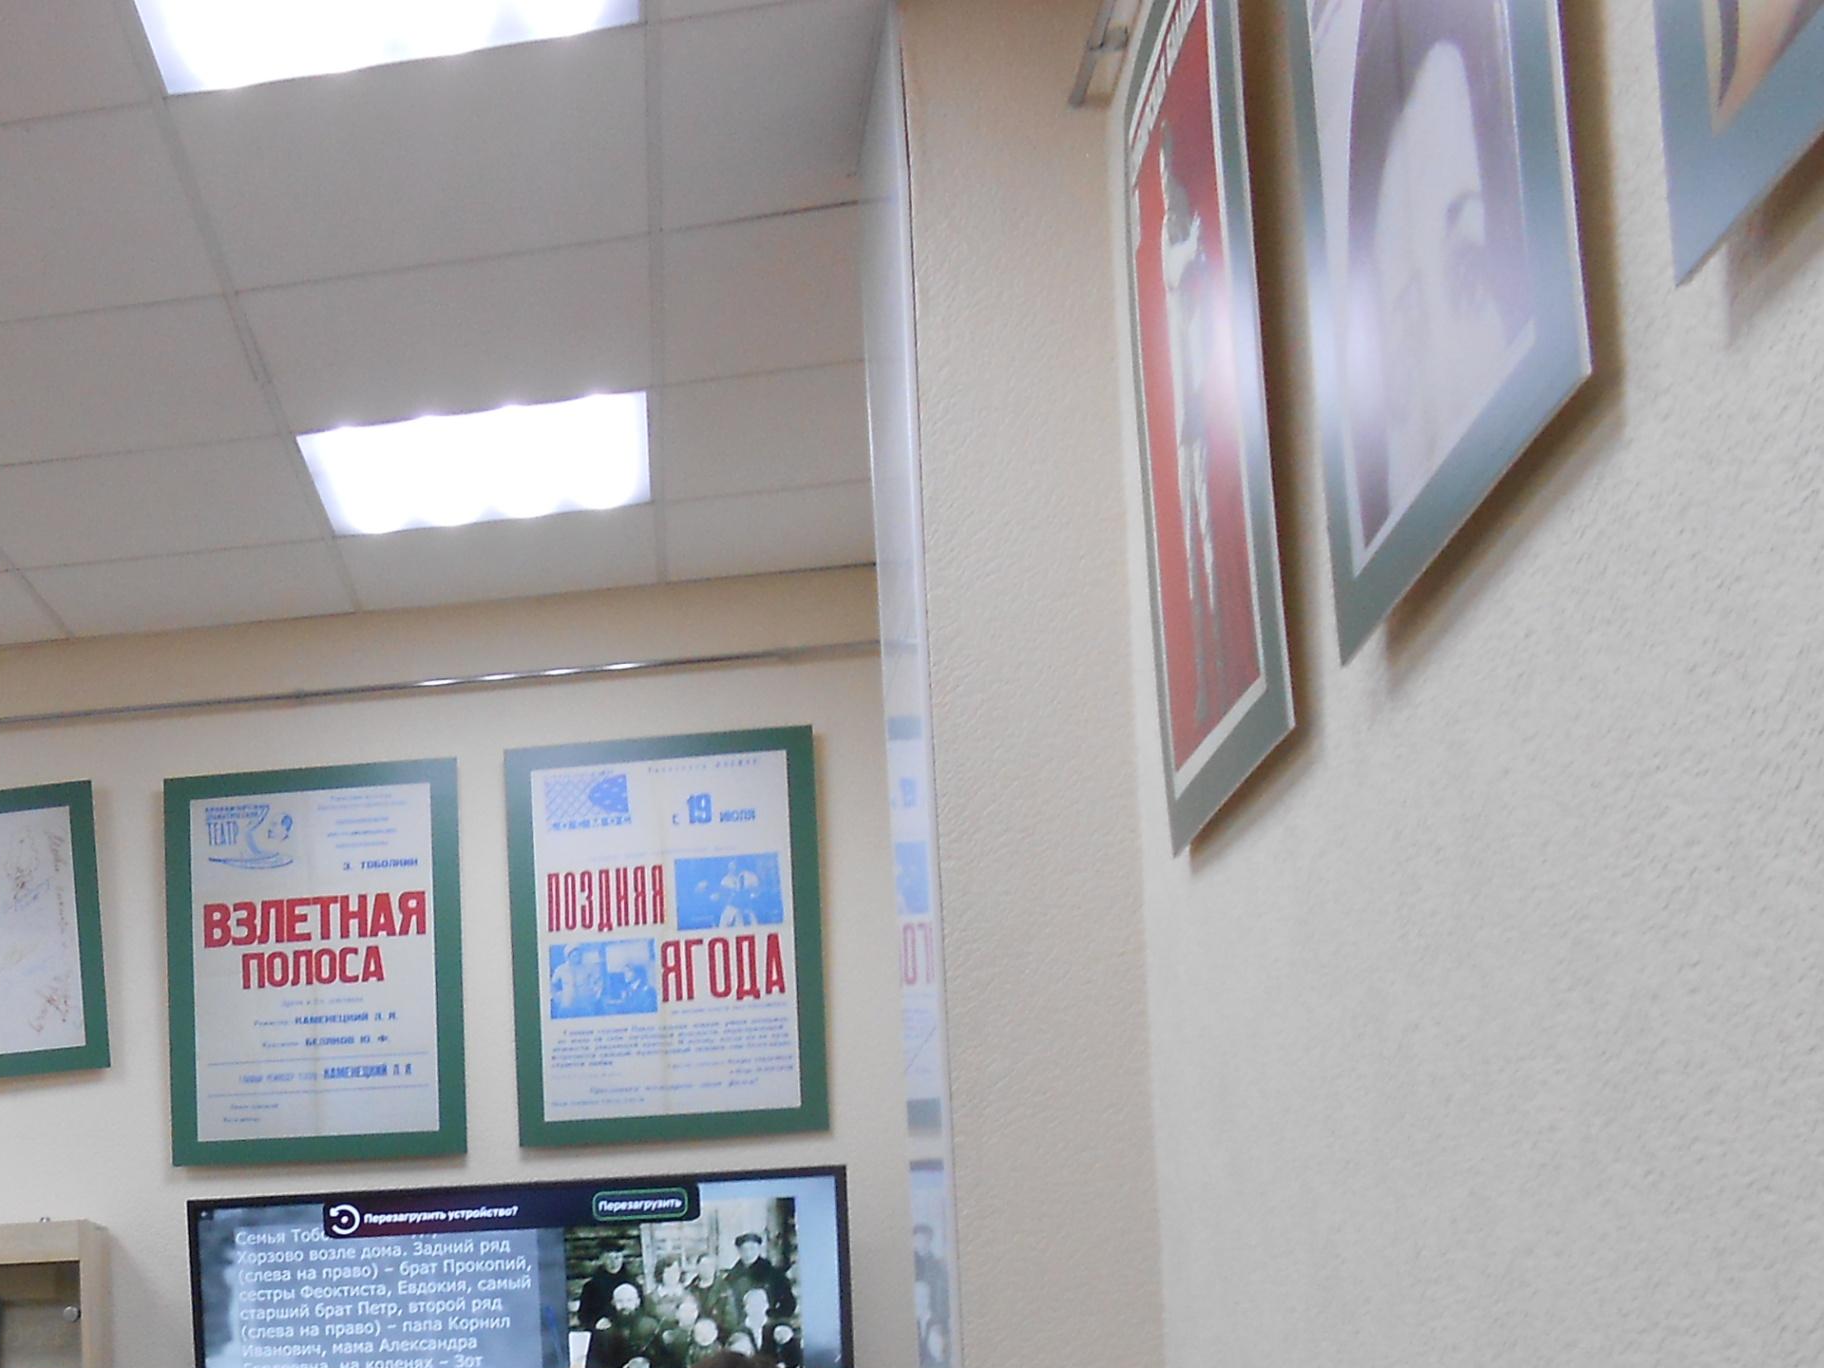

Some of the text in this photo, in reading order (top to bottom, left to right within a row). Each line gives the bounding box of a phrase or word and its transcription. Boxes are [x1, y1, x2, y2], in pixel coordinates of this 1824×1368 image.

[688, 793, 713, 824] 19
[207, 820, 240, 846] ТЕАТР
[547, 864, 666, 933] ПОЗДНЯЯ
[203, 890, 426, 949] ВЗЛЕТНАЯ
[241, 945, 386, 990] ПОЛОСА
[660, 932, 786, 1002] ЯГОДА
[364, 1206, 518, 1225] Перезагрузить устройство?
[598, 1199, 683, 1213] Перезагрузить
[235, 1231, 285, 1246] Семья
[237, 1239, 511, 1266] Хорзово возле дома. Задний ряд
[238, 1269, 291, 1284] (слева
[297, 1270, 317, 1281] на
[322, 1263, 378, 1281] право)
[399, 1261, 438, 1278] брат
[443, 1255, 532, 1276] Прокопий,
[239, 1274, 532, 1303] сестры Феоктиста, Евдокия, самый
[240, 1297, 503, 1322] старший брат Петр, второй ряд
[241, 1325, 294, 1342] (слева
[300, 1326, 320, 1338] на
[325, 1319, 381, 1338] право)
[402, 1320, 442, 1333] папа
[448, 1315, 511, 1332] Корнил
[242, 1337, 478, 1358] Иванович, мама Александра
[453, 1354, 484, 1368] Зот
